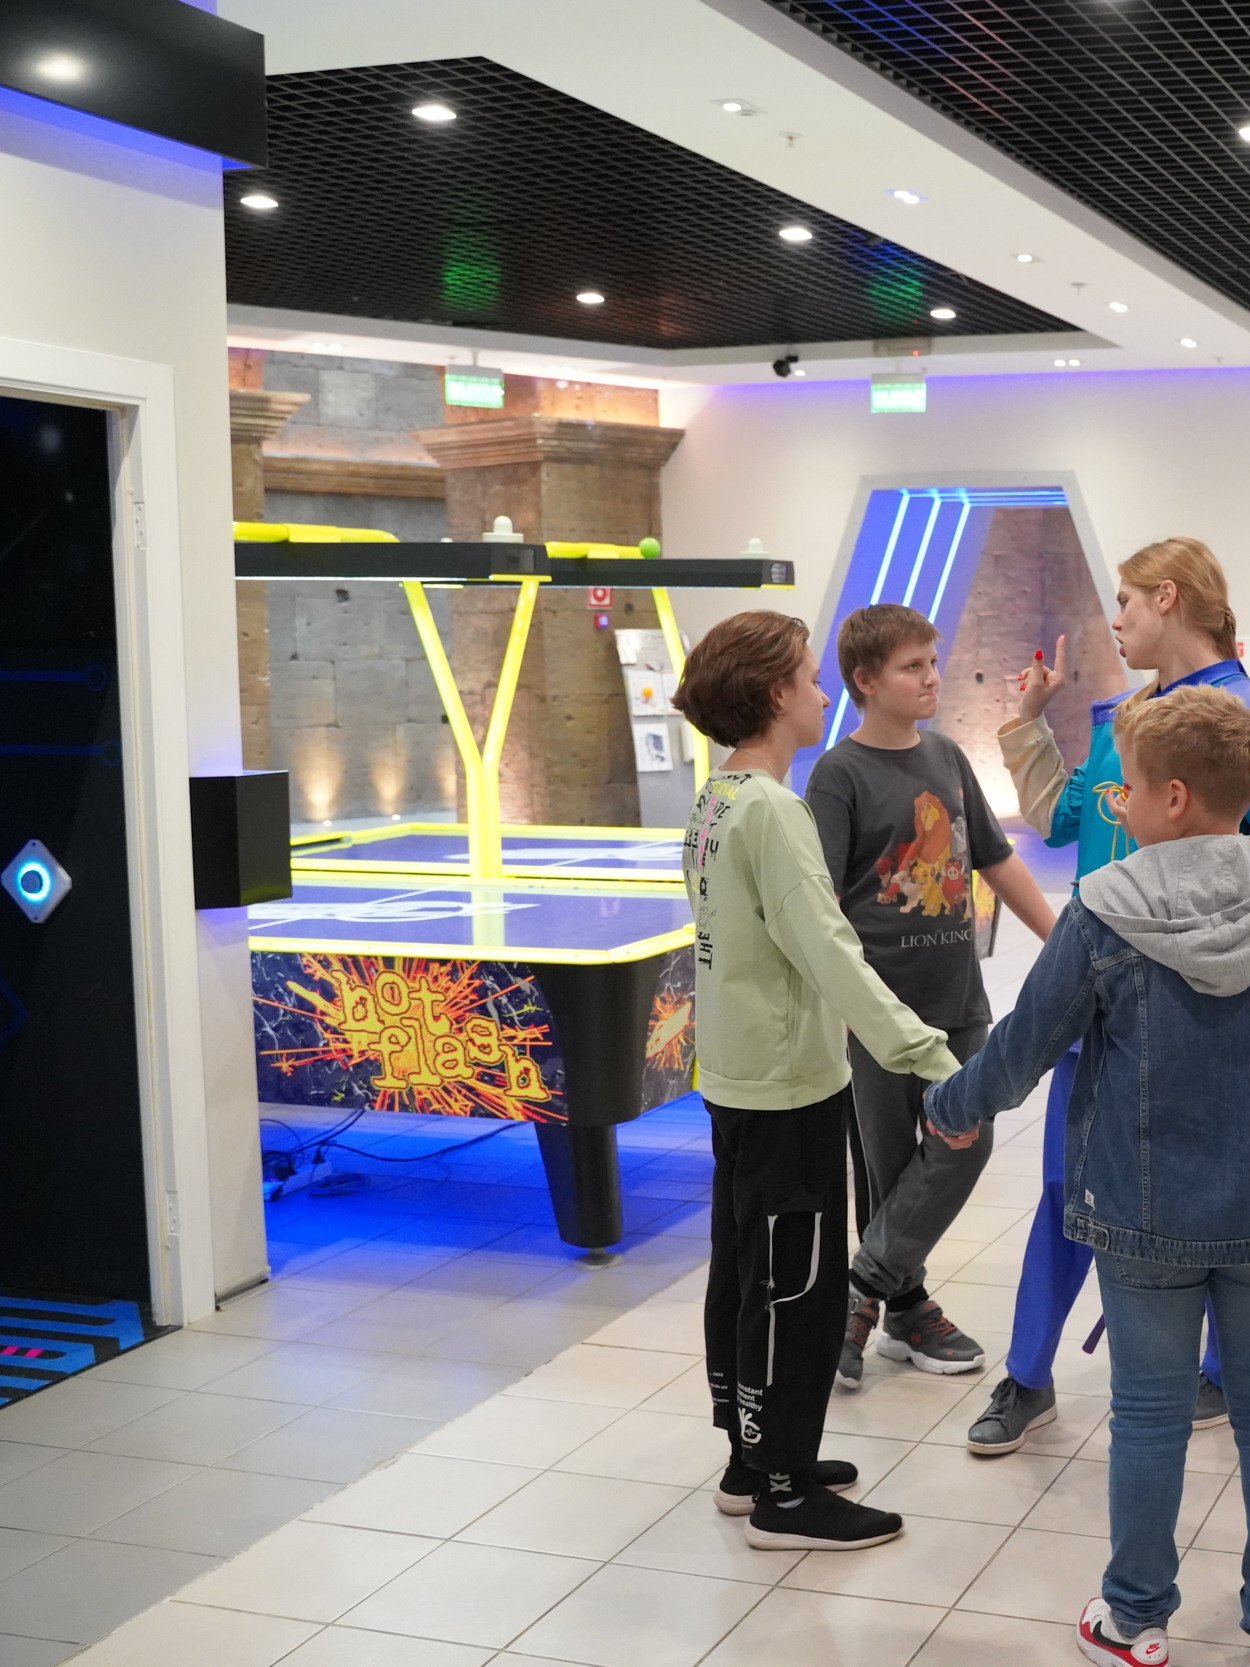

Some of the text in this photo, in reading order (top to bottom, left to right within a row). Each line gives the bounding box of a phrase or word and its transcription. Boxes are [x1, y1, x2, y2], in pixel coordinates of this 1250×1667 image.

[901, 929, 972, 947] LION KING
[330, 969, 451, 1036] hot
[368, 1016, 551, 1101] flash
